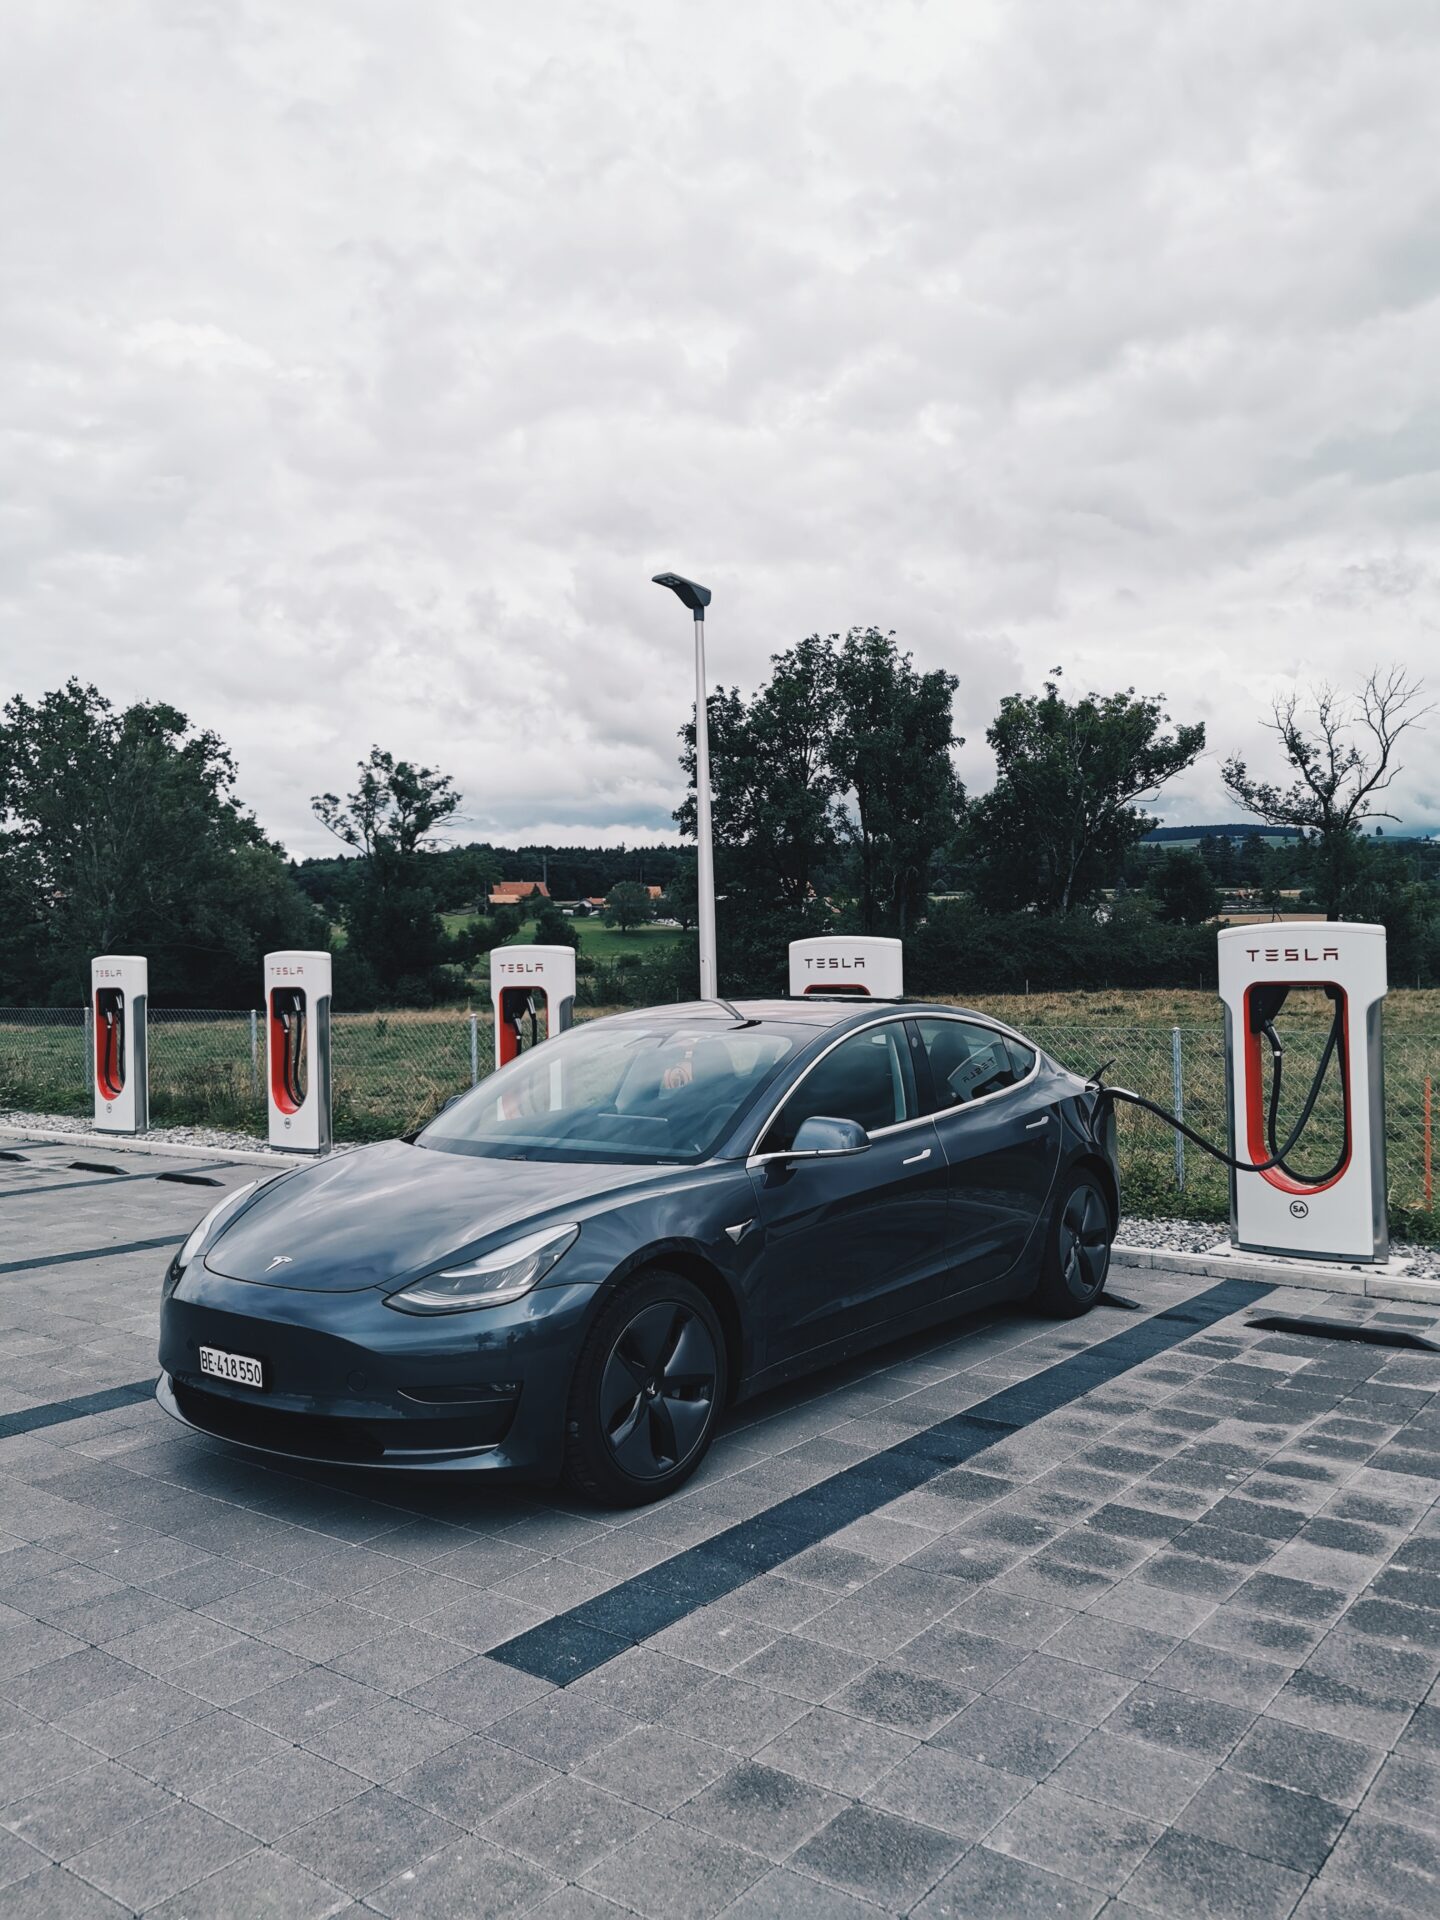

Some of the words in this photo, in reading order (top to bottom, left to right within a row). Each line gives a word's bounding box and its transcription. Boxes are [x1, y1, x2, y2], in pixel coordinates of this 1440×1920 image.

[1246, 948, 1338, 961] TESLA
[804, 957, 865, 968] TESLA
[270, 966, 304, 976] TESLA
[500, 963, 544, 973] TESLA
[95, 969, 122, 978] TESLA
